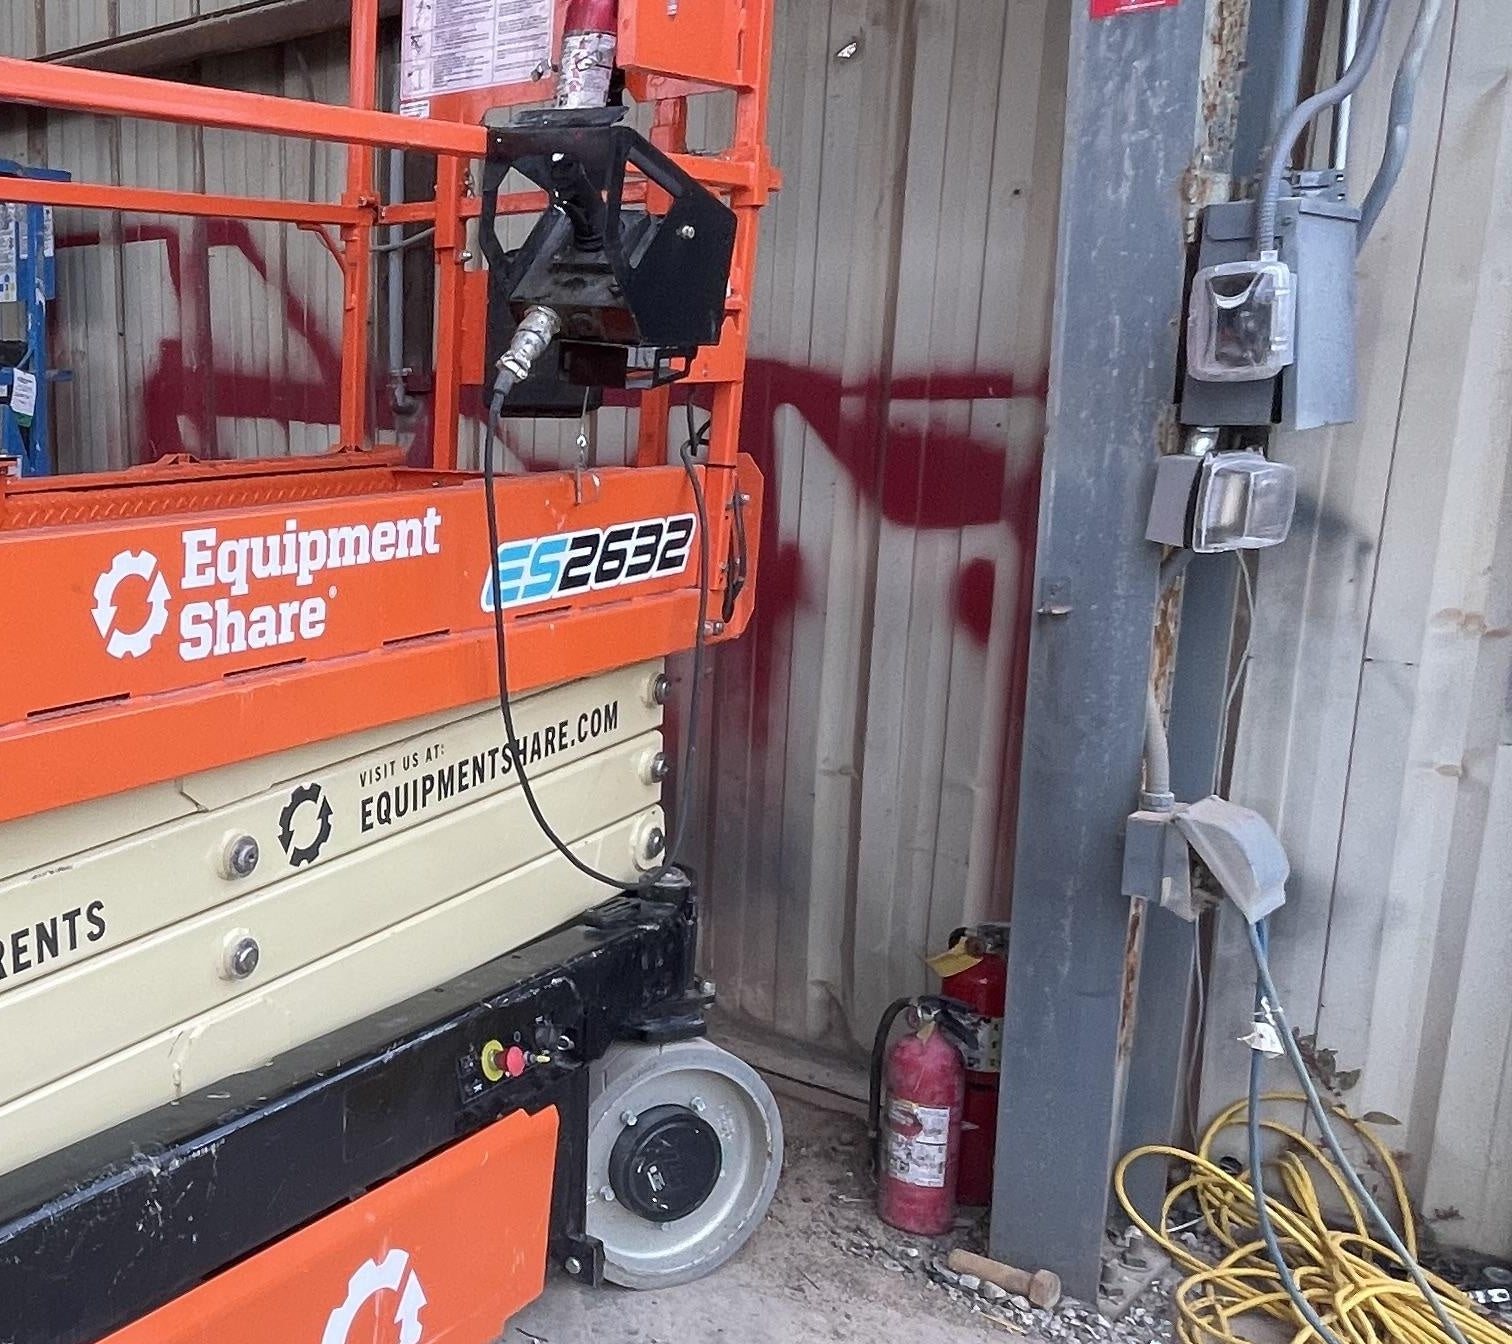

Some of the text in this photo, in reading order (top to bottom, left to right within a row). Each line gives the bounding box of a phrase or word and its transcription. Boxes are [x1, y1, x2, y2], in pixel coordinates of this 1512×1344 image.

[180, 506, 443, 597] Equipment
[486, 515, 694, 608] ES2632
[179, 596, 327, 661] Share
[359, 742, 446, 788] VISIT US AT:
[360, 699, 619, 834] EQUIPMENTSHARE.COM
